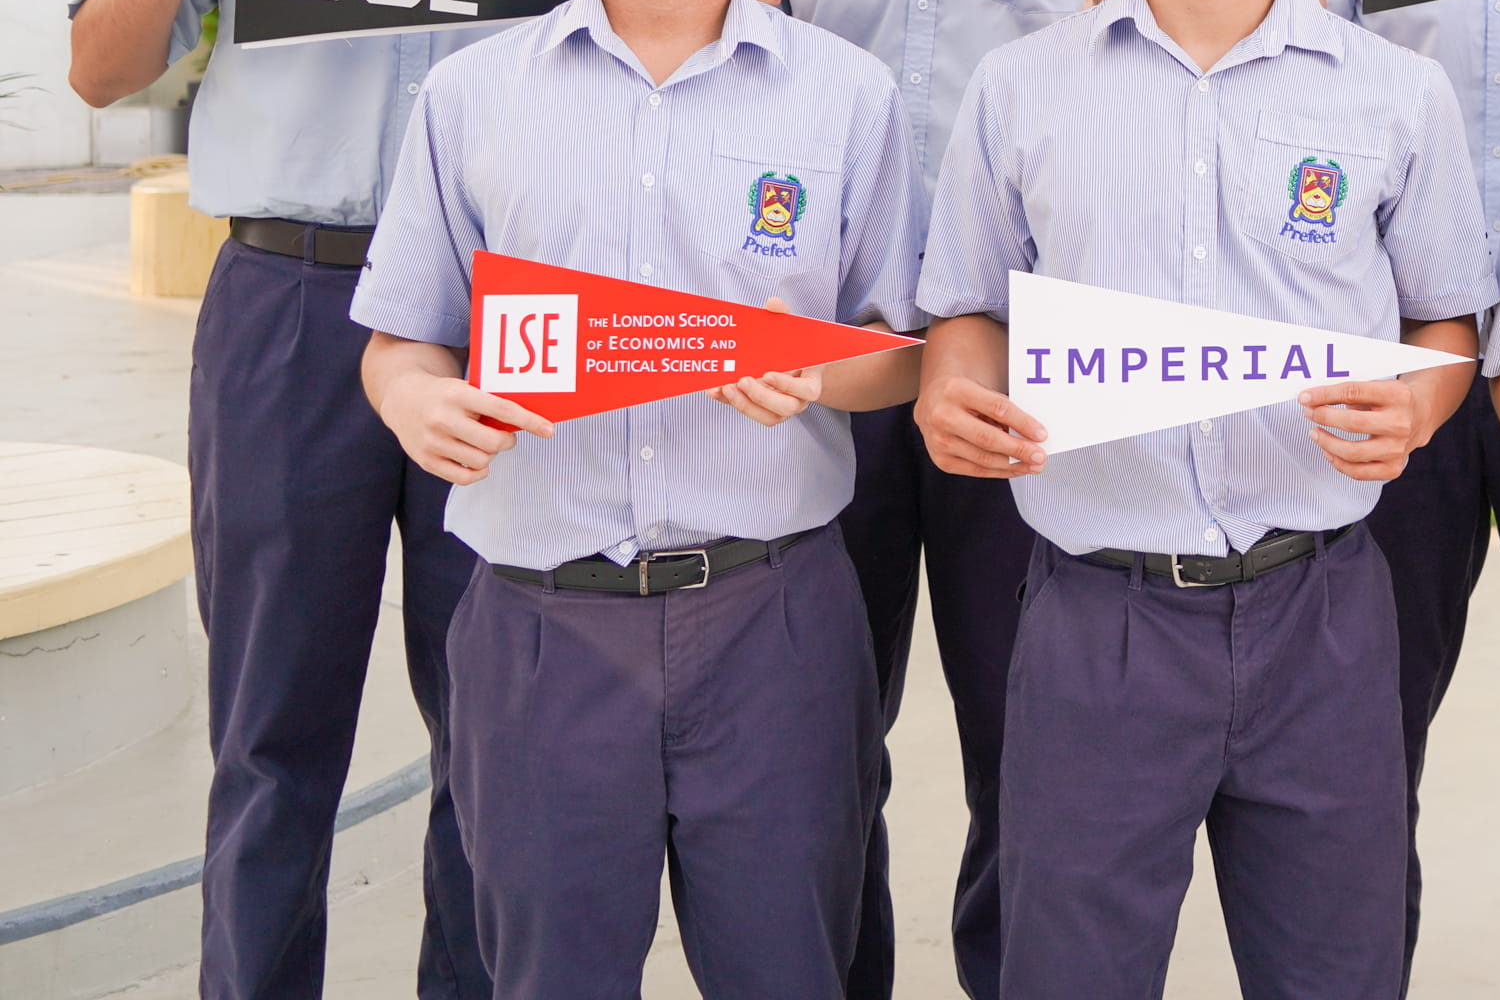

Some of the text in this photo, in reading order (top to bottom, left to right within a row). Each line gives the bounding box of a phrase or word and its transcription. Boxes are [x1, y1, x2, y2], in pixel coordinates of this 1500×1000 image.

[1279, 221, 1337, 244] Prefect
[742, 235, 798, 258] Prefect
[587, 312, 737, 328] THE LONDON SCHOOL
[498, 313, 560, 374] LSE
[586, 335, 737, 351] OF ECONOMICS AND
[586, 357, 719, 373] POLITICAL SCIENCE
[1026, 343, 1350, 385] IMPERIAL
